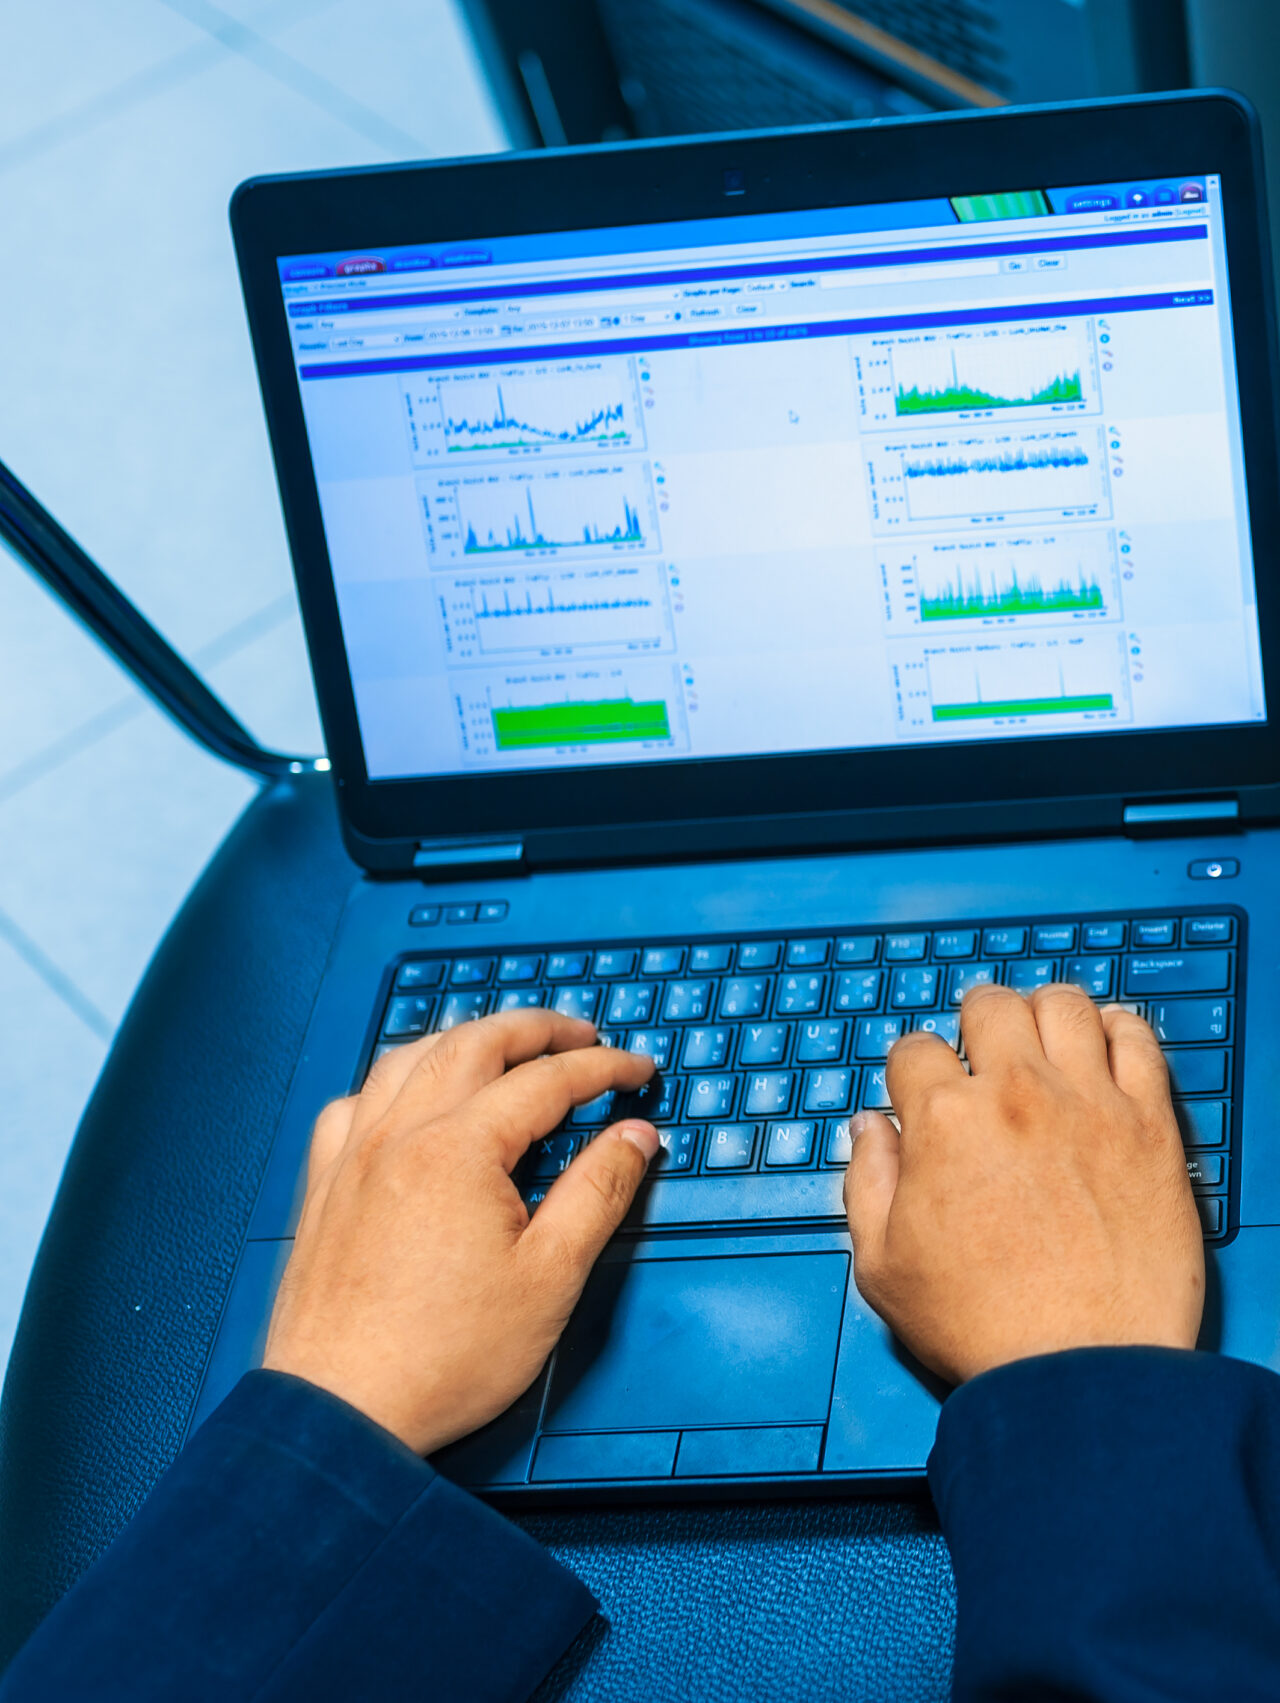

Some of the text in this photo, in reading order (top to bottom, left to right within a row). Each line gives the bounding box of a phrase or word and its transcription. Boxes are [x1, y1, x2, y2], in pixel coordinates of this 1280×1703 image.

[1089, 927, 1109, 936] End
[1139, 925, 1168, 935] Insert
[1191, 921, 1225, 931] Delete
[989, 933, 1008, 943] F12
[1132, 958, 1185, 968] Backspace
[693, 1031, 705, 1045] T
[751, 1027, 762, 1042] Y
[807, 1024, 820, 1039] U
[635, 1034, 647, 1048] R
[755, 1077, 768, 1090] H
[814, 1075, 823, 1088] J
[872, 1072, 885, 1085] K
[697, 1080, 711, 1095] G
[717, 1131, 728, 1144] B
[777, 1127, 791, 1141] N
[835, 1125, 850, 1138] M
[659, 1133, 672, 1147] V
[541, 1140, 554, 1155] X
